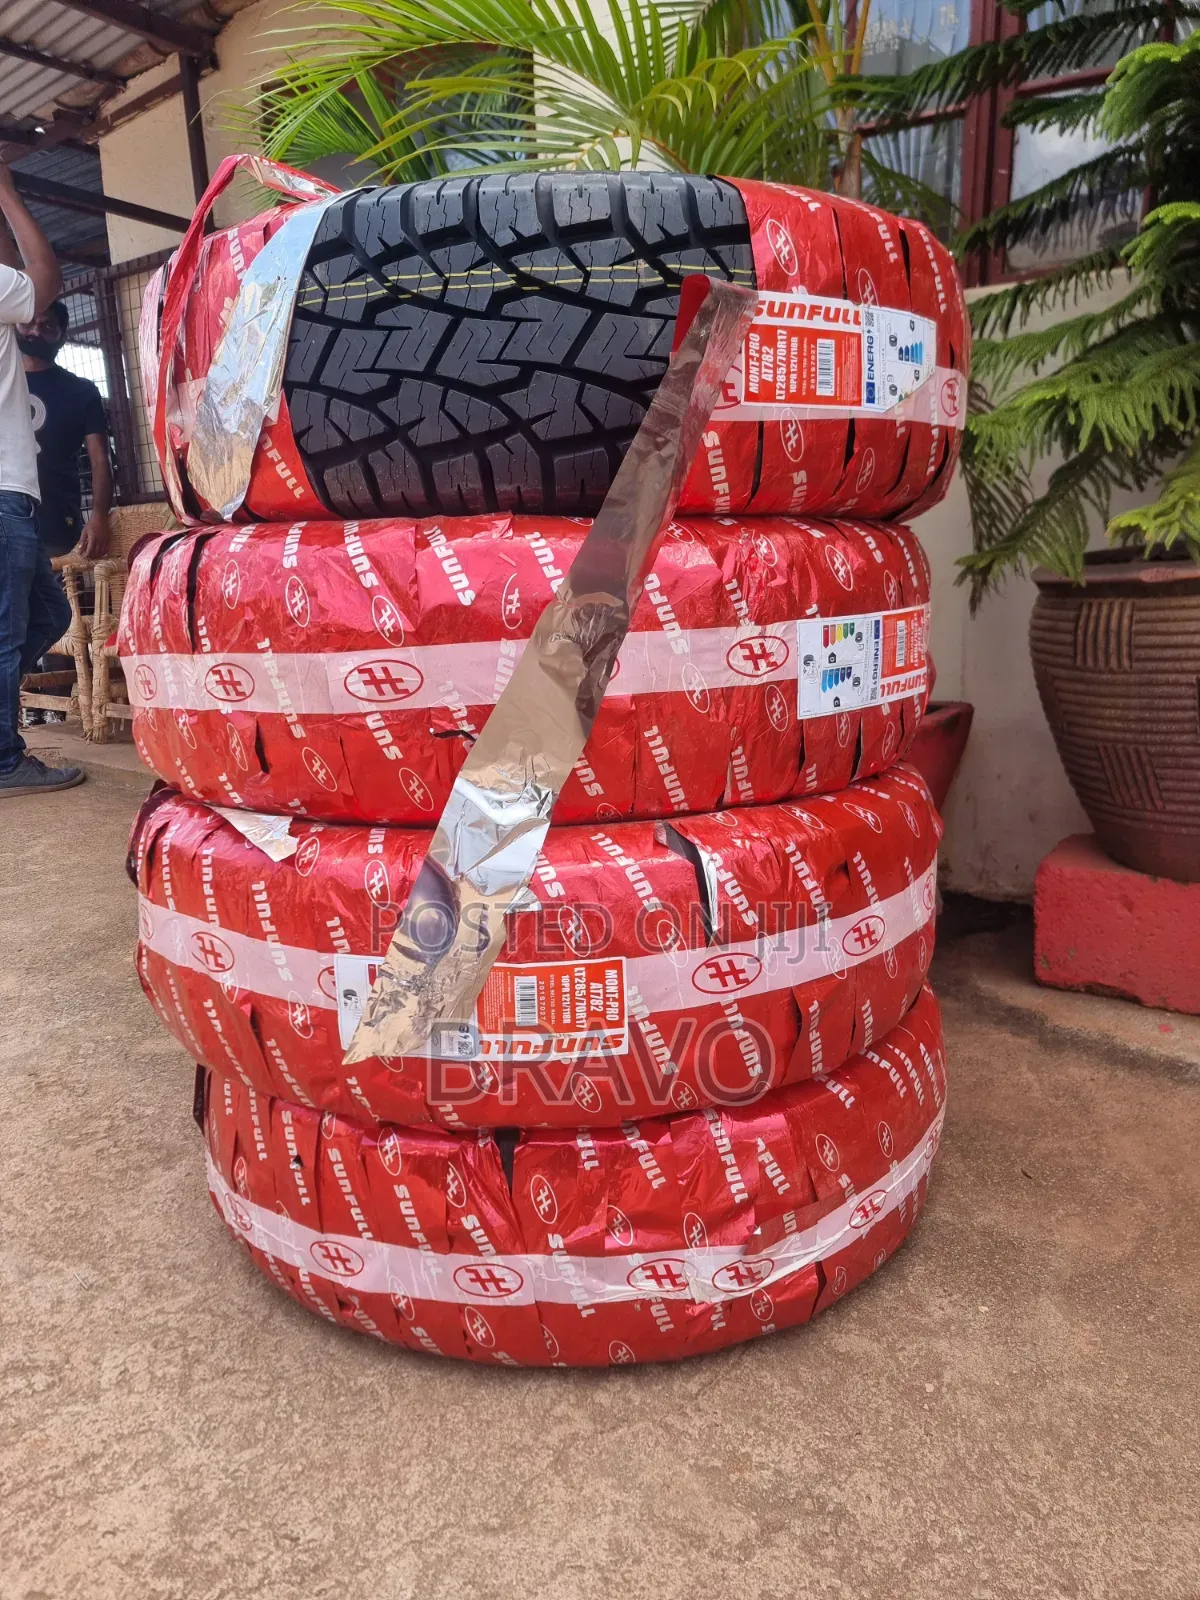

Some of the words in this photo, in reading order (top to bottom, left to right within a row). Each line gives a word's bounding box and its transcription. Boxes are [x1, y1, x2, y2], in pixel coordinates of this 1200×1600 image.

[748, 333, 760, 394] MONT-PRO
[761, 346, 774, 382] AT782
[776, 329, 787, 400] LT285/70R17
[260, 432, 305, 499] NFULL
[644, 573, 690, 655] SUNFU
[561, 975, 570, 993] 10PR
[562, 994, 571, 1024] 121/118R
[574, 967, 588, 1029] LT285/70R17
[589, 982, 603, 1012] AT782
[605, 969, 619, 1021] MONT-PRO
[479, 1033, 625, 1055] SUNFULL
[858, 1048, 907, 1098] NFULL
[622, 1121, 666, 1189] NFULL
